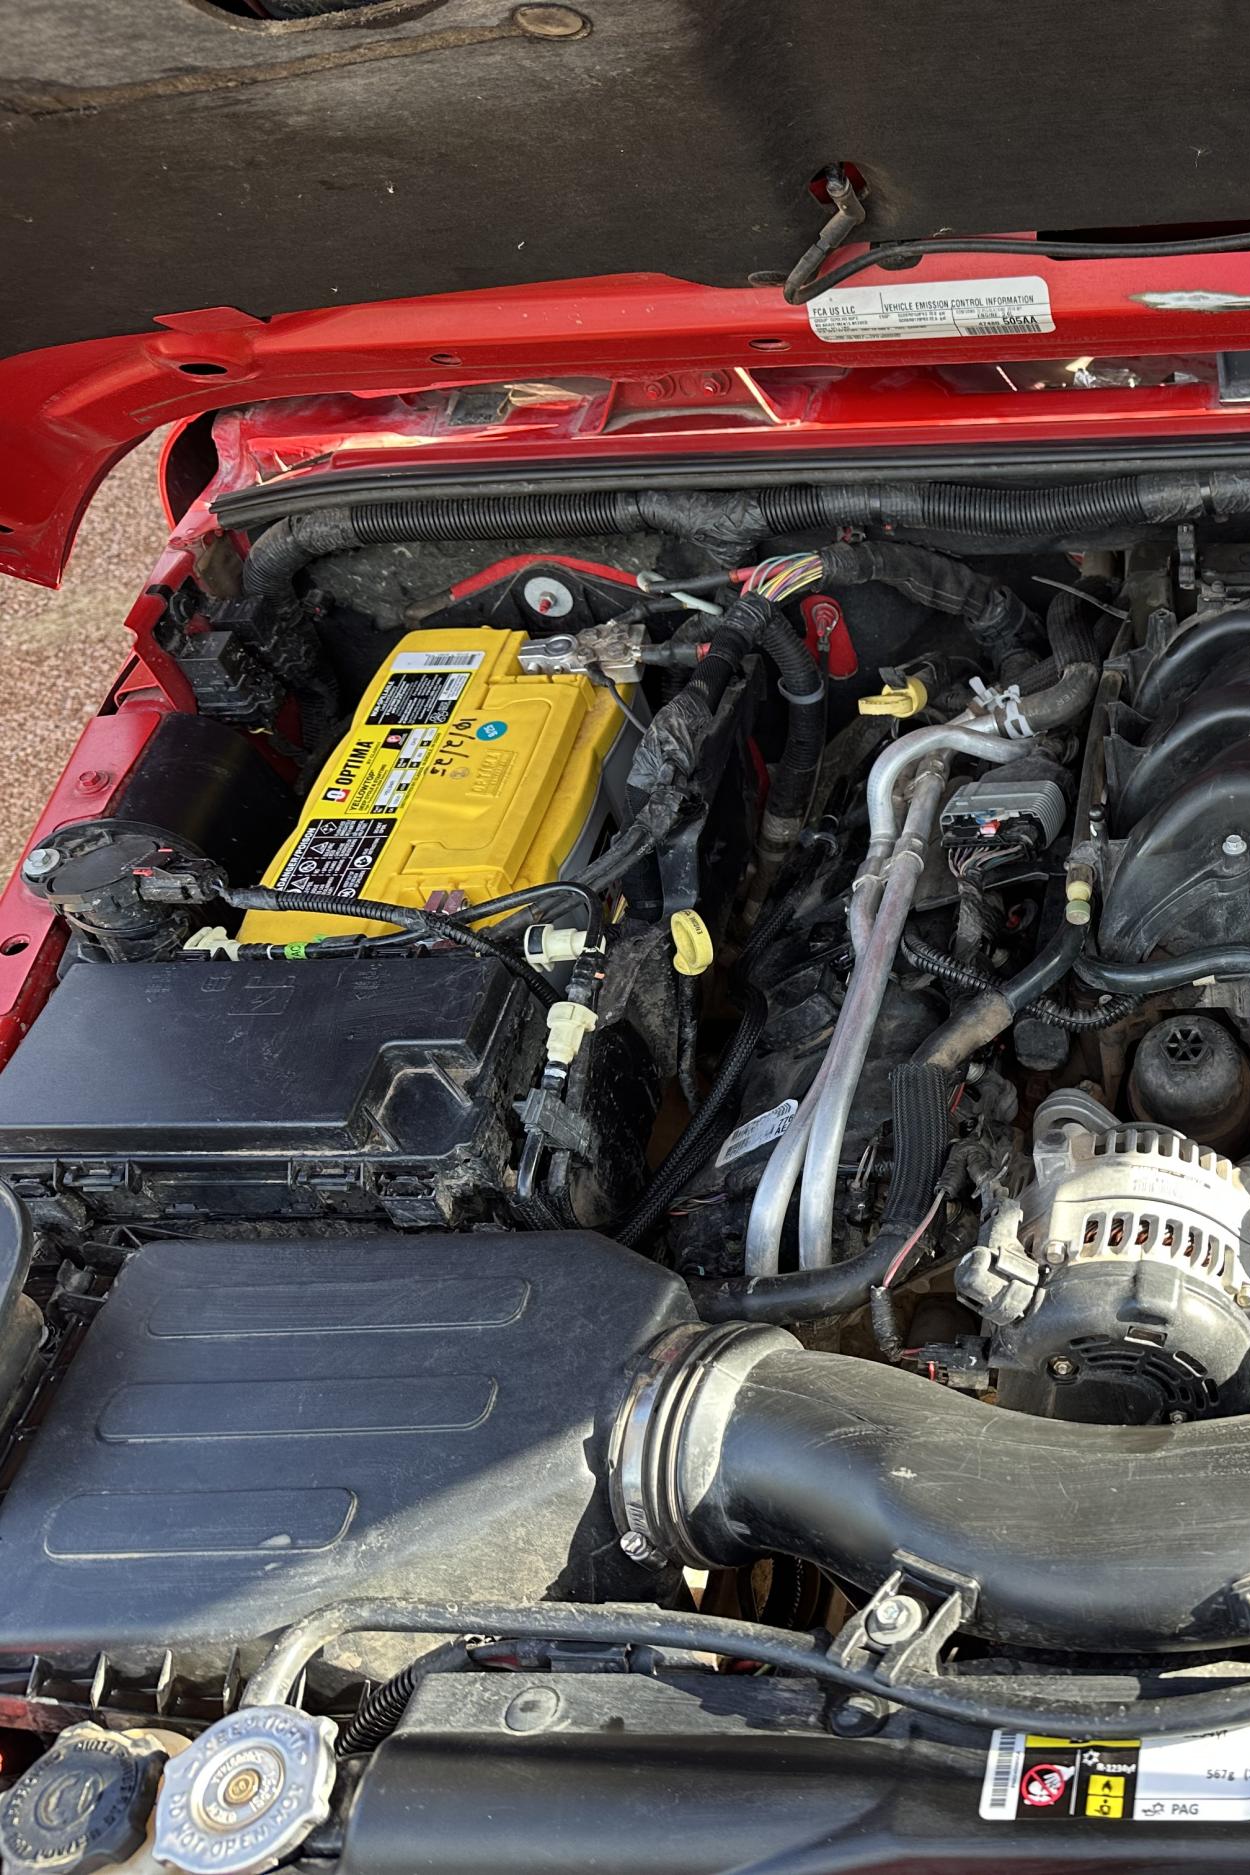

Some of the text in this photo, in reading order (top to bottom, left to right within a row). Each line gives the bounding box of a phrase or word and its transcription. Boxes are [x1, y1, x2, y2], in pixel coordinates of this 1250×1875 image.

[884, 295, 1034, 312] VEHICLE EMISSION CONTROL INFORMATION
[813, 305, 855, 316] FCA US LLC
[1002, 316, 1037, 326] 505AA
[334, 738, 375, 786] OPTIMA
[276, 827, 317, 888] DANGER/POISON
[1096, 1763, 1136, 1774] R-1234yf
[1206, 1768, 1235, 1781] 567g
[1171, 1803, 1199, 1816] PAG
[211, 1823, 269, 1857] OPEN
